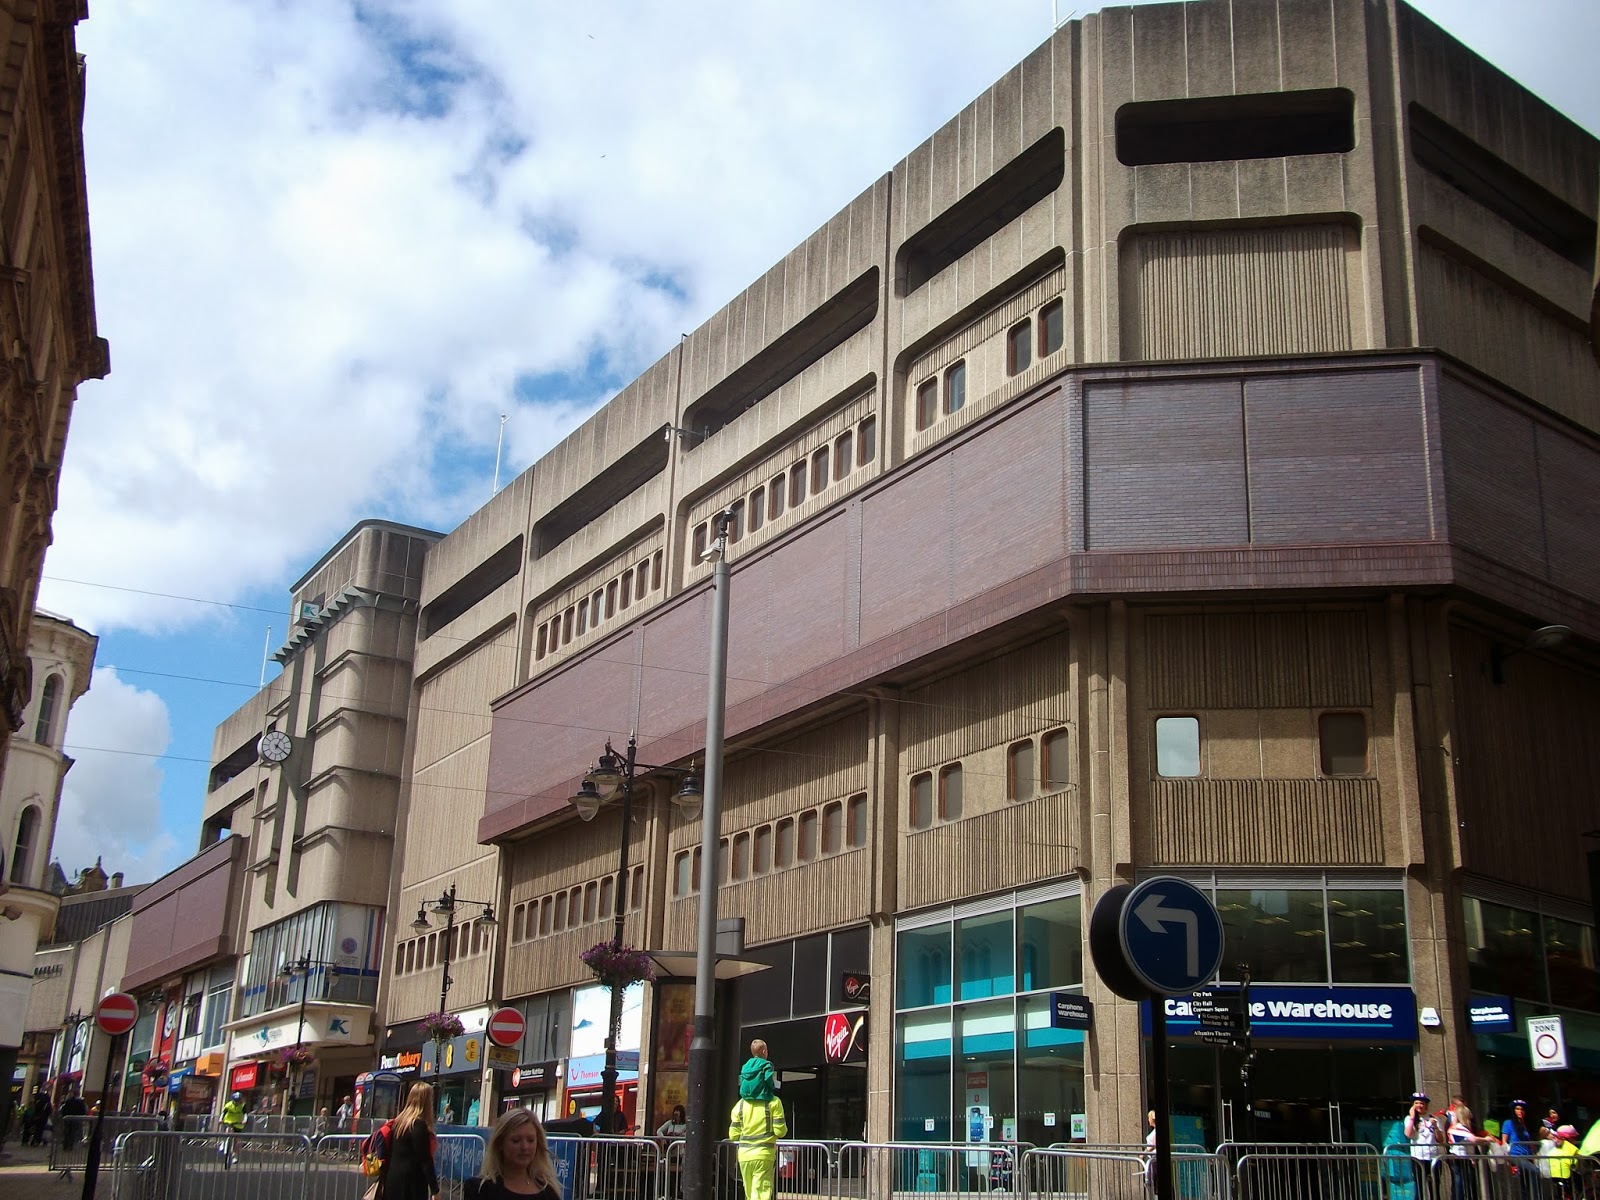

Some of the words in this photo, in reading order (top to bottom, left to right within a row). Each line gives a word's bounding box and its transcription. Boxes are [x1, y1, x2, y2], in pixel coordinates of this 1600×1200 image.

[1057, 1002, 1084, 1011] Carphone
[1267, 999, 1393, 1019] Warehouse
[1057, 1010, 1089, 1019] Warehouse
[1534, 1024, 1556, 1033] ZONE
[826, 1018, 849, 1058] Virgin
[580, 1070, 599, 1080] Thomson
